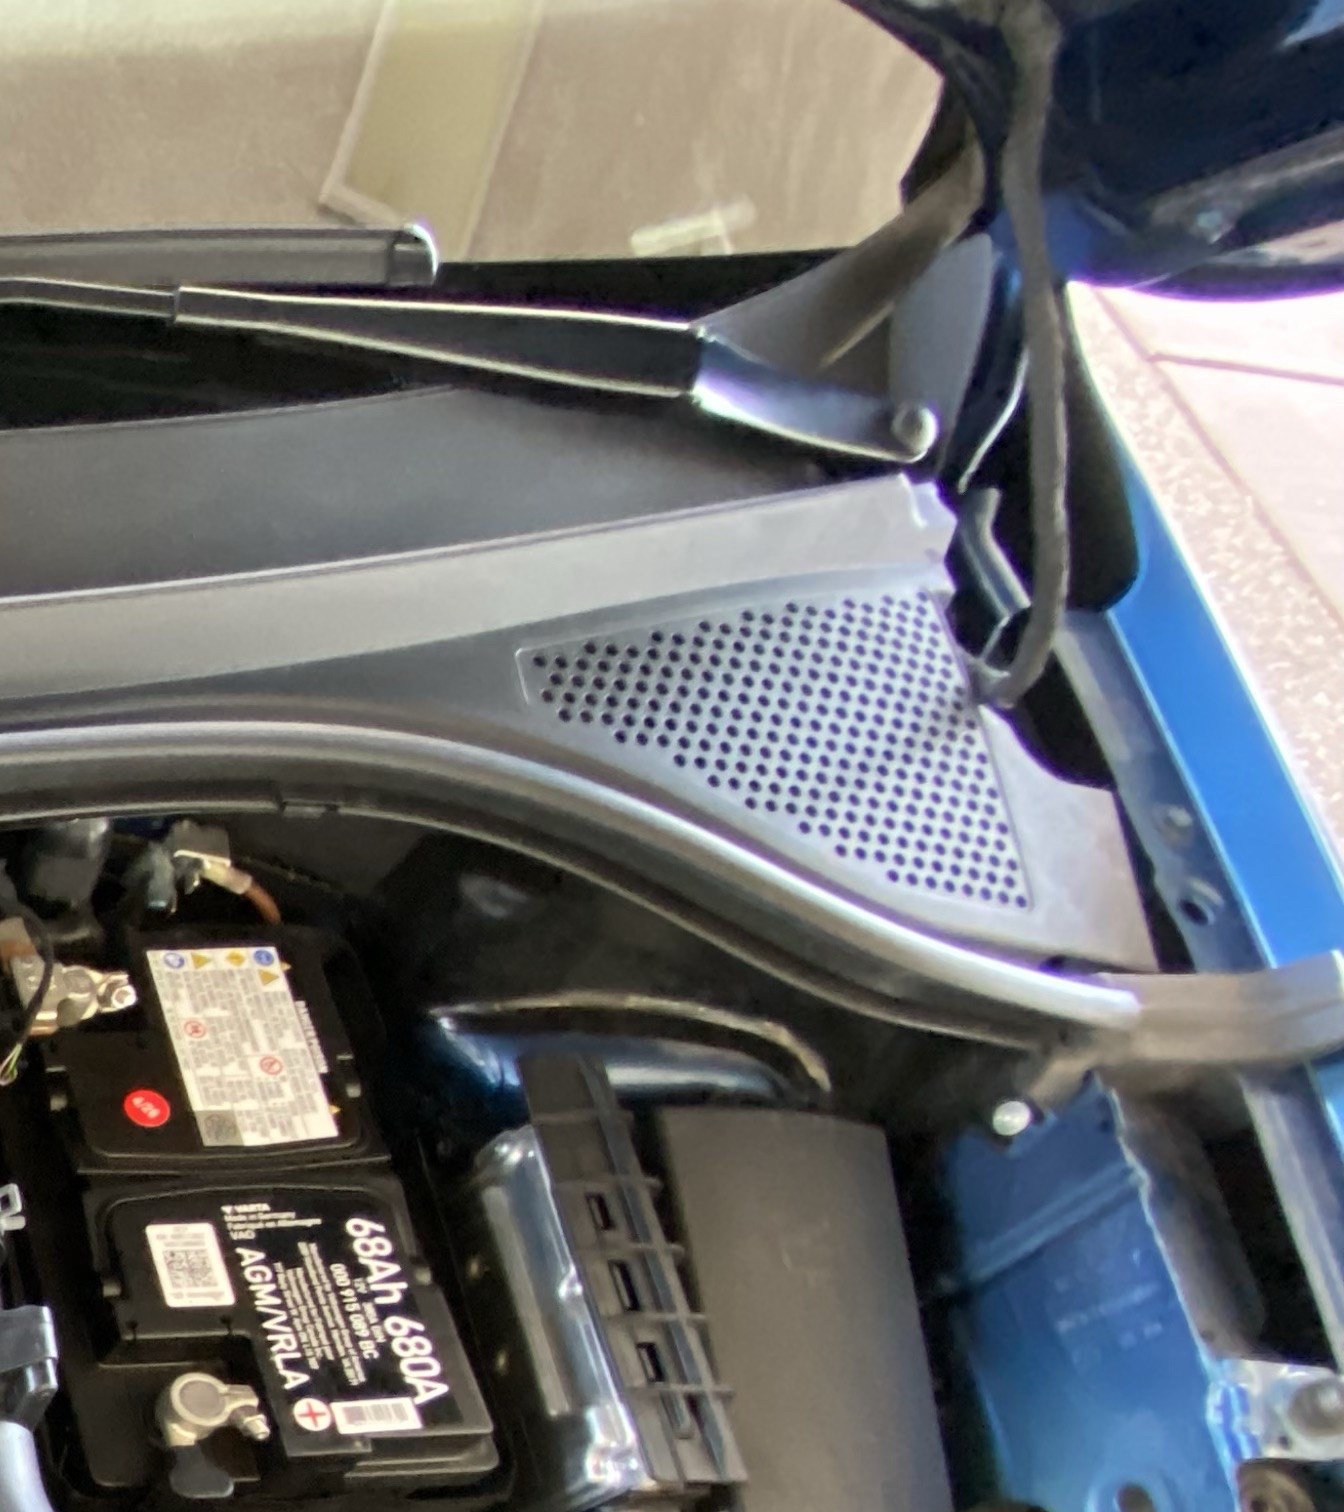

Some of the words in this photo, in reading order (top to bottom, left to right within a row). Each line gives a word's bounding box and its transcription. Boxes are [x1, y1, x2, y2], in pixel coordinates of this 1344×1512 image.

[234, 1247, 311, 1391] AGM/VRLA
[345, 1217, 409, 1305] 68Ah
[383, 1315, 450, 1405] 680A
